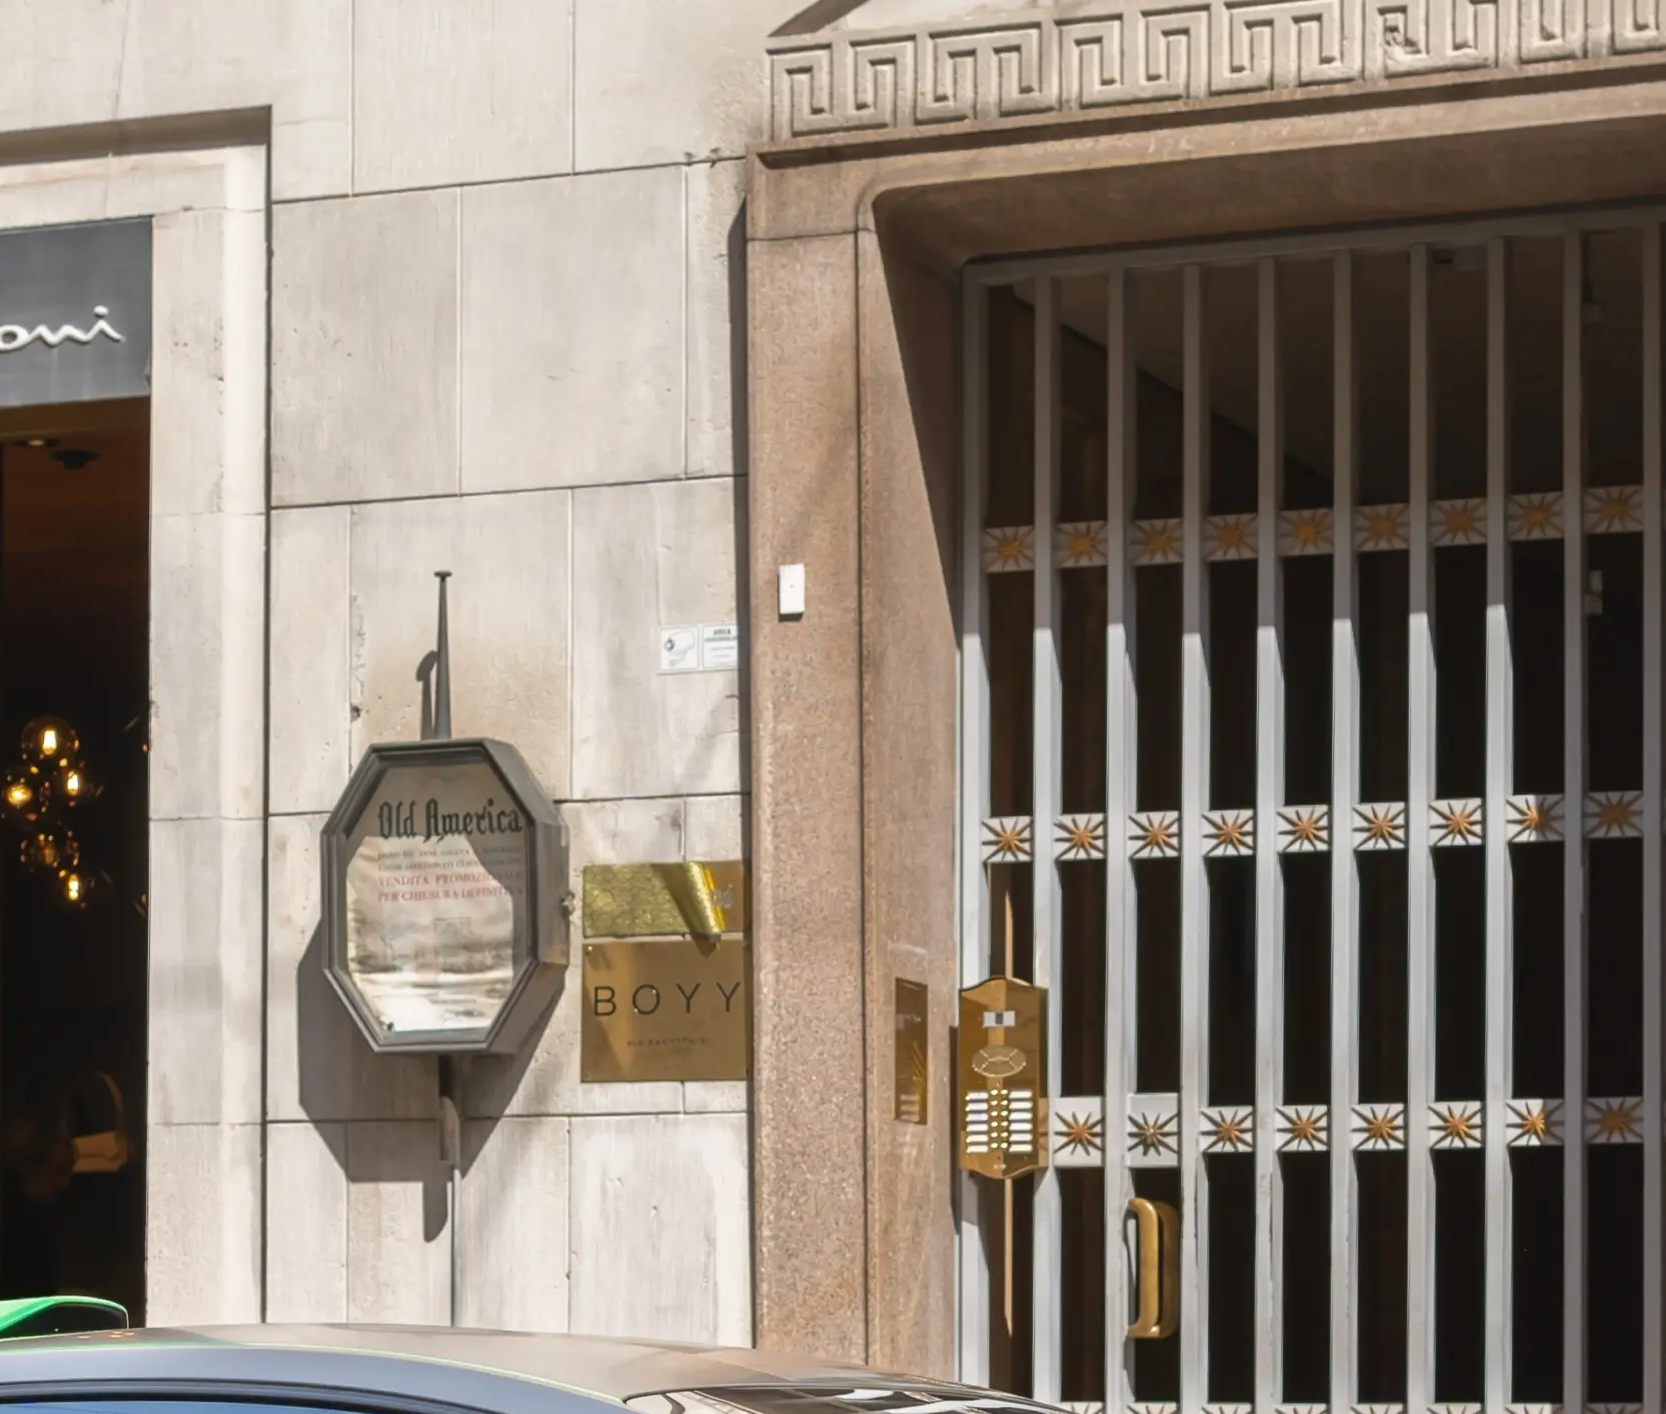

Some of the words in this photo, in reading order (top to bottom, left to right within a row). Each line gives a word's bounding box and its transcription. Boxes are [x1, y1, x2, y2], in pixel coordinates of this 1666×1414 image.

[378, 799, 417, 841] Old
[422, 796, 524, 844] America
[593, 981, 741, 1016] BOYY
